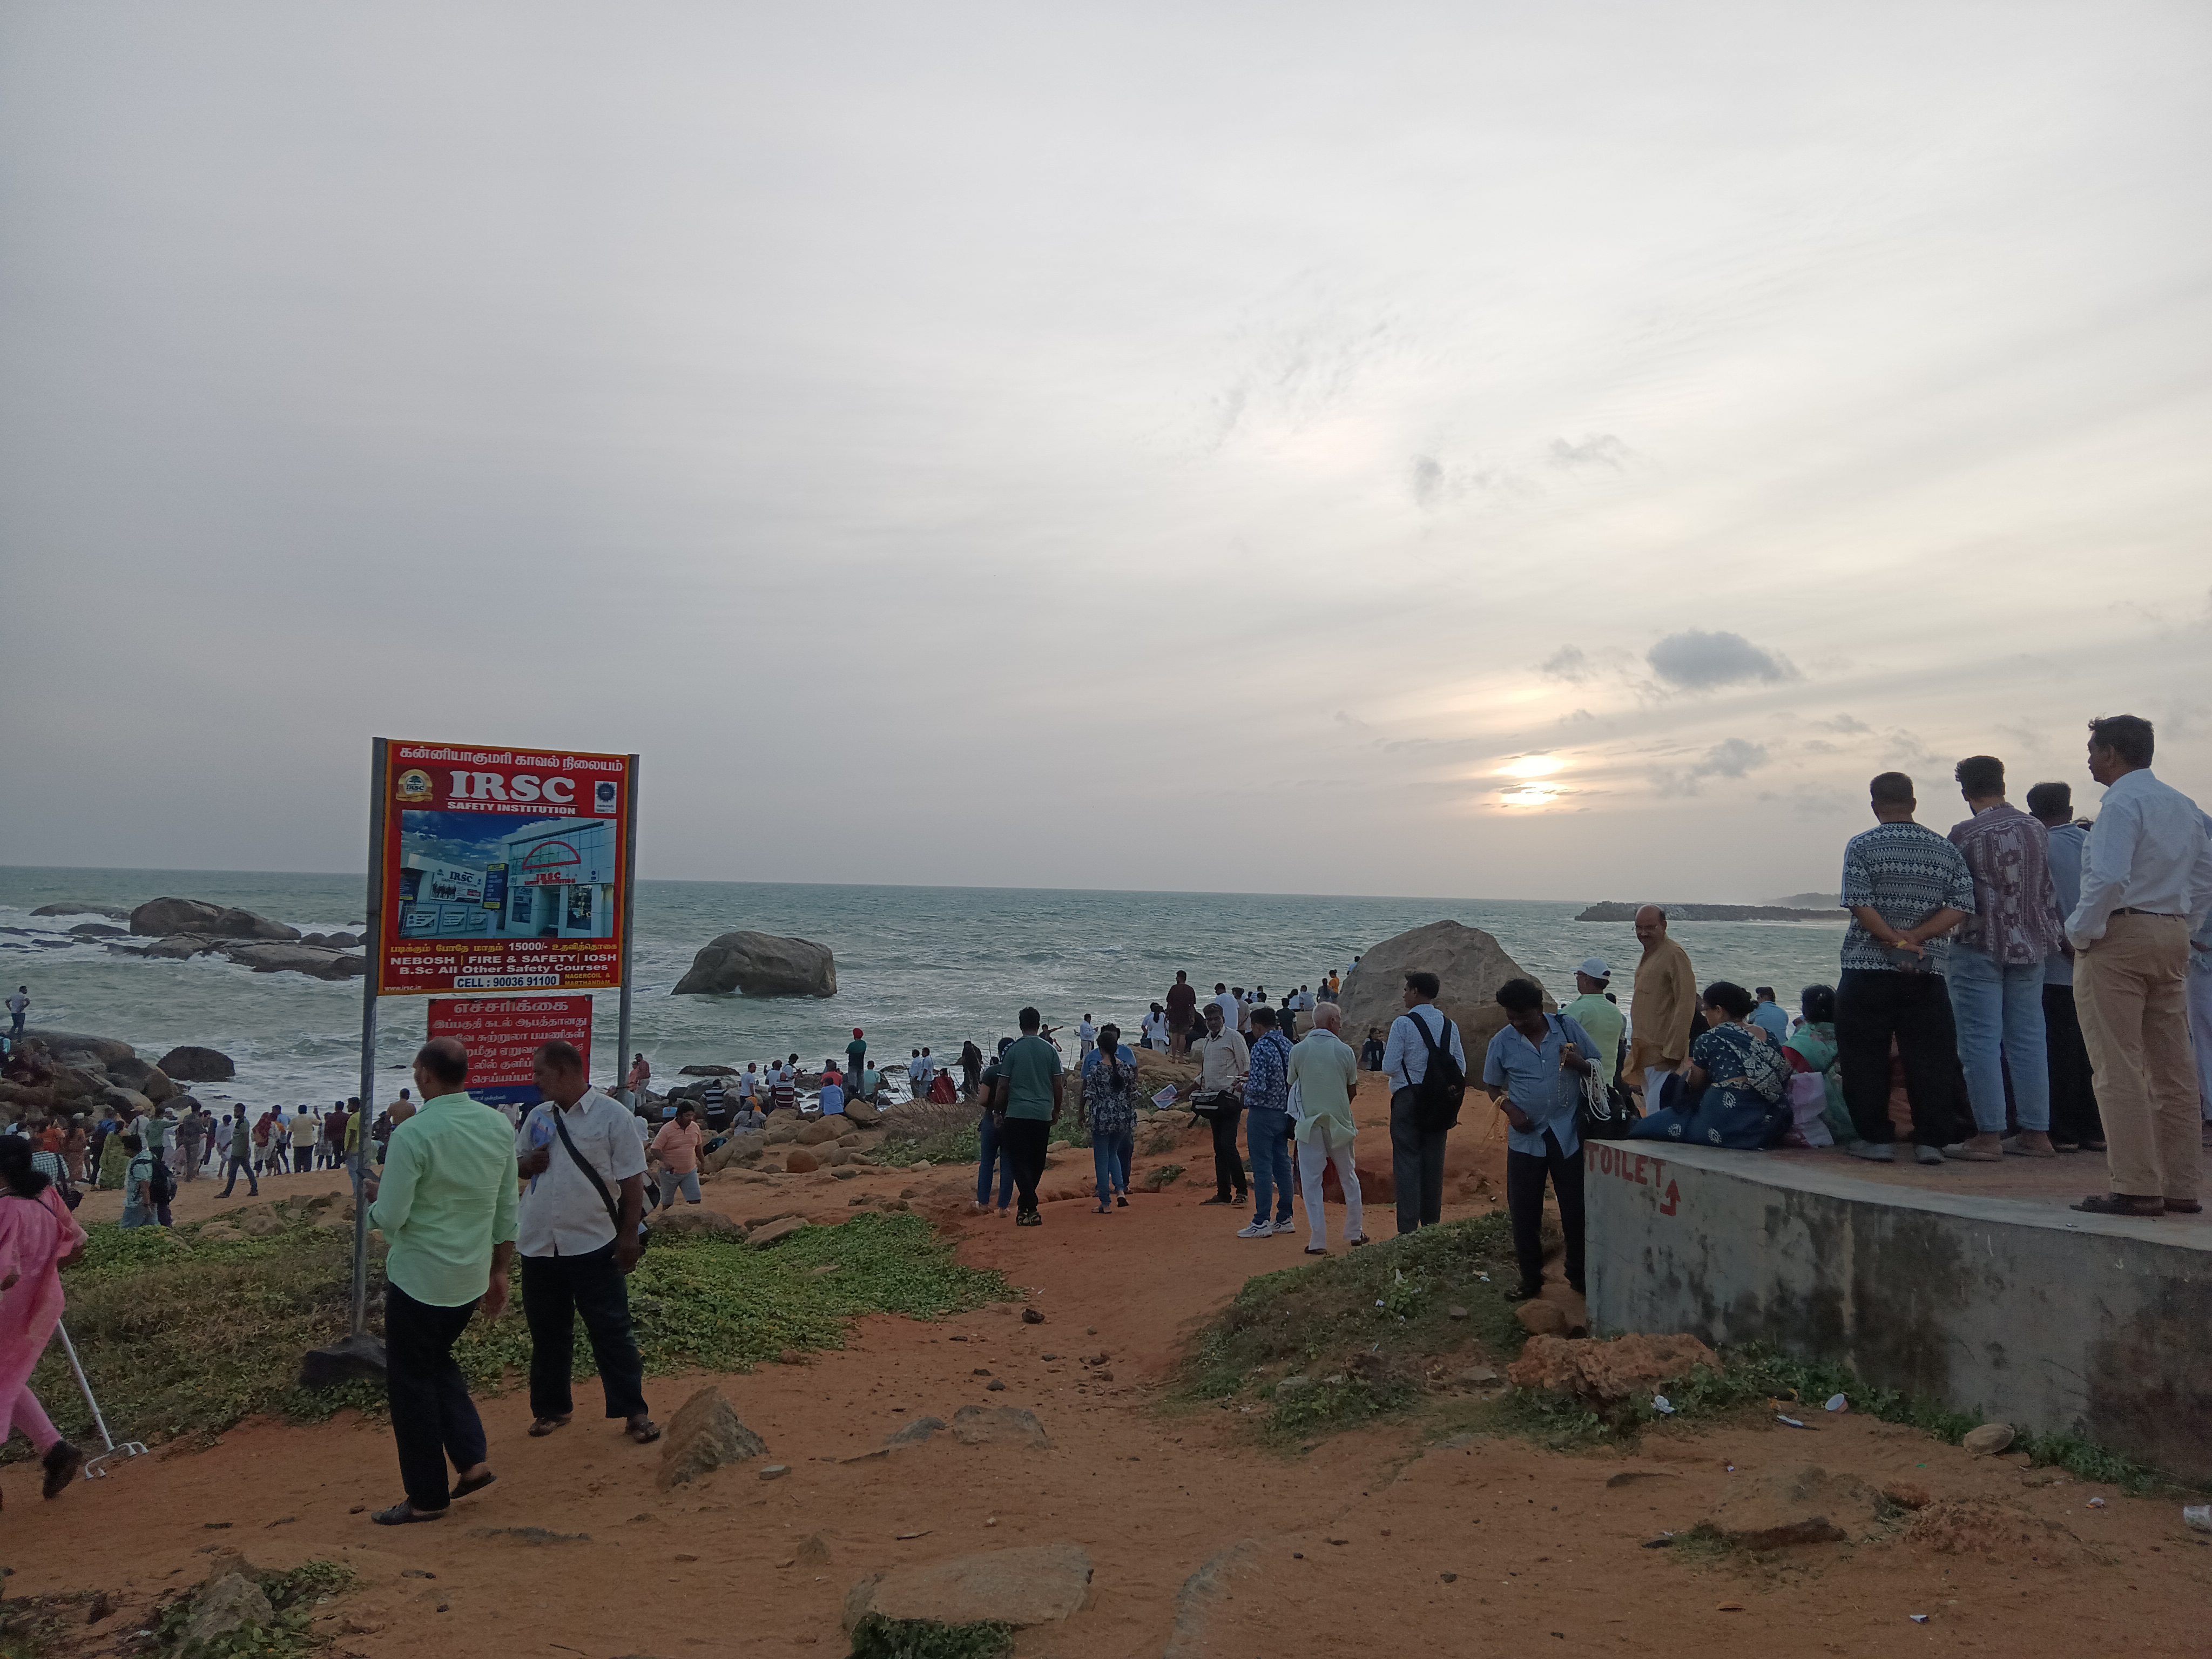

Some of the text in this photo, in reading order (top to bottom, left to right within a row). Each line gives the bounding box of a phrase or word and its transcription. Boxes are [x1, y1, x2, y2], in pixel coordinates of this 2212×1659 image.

[400, 745, 623, 772] கன்னியாகுமரி காவல் நிலையம்
[449, 770, 576, 803] IRSC
[447, 801, 576, 814] SAFETY INSTITUTION
[449, 871, 473, 883] IRSC
[509, 942, 548, 951] 15000/-
[390, 954, 616, 965] NEBOSH FIRE & SAFETY IOSH
[399, 966, 434, 975] B.Sc
[438, 966, 457, 974] All
[506, 964, 551, 973] Safety
[457, 978, 484, 988] CELL
[493, 976, 524, 987] 90036
[527, 976, 556, 986] 91100
[454, 999, 569, 1013] எச்சரிக்கை
[433, 1017, 482, 1029] இப்பகுதி
[484, 1016, 513, 1028] கடல்
[1584, 1141, 1667, 1188] TOILET
